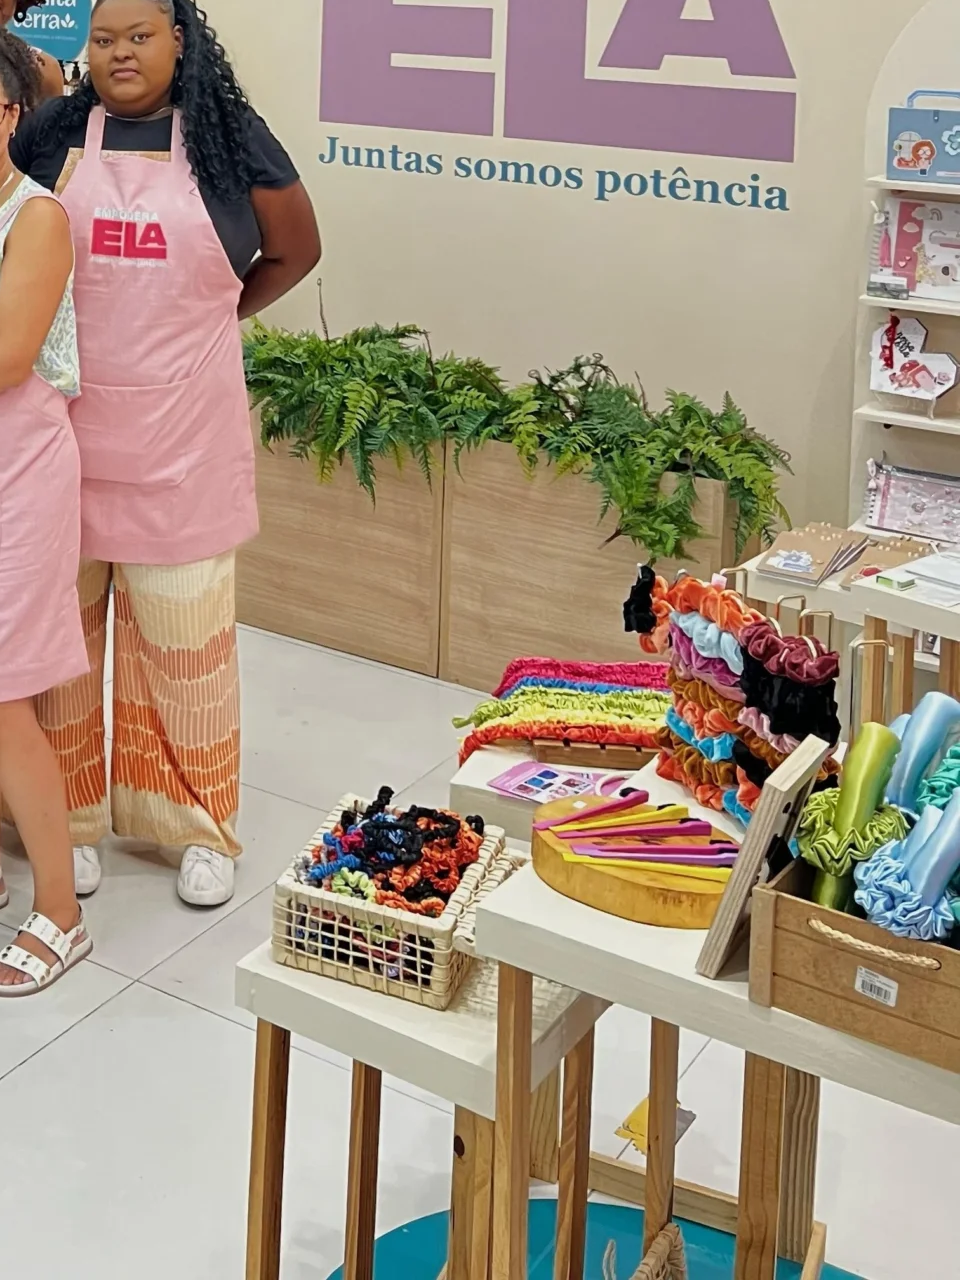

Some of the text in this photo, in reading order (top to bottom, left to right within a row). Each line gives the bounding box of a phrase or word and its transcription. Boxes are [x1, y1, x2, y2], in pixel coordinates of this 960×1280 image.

[318, 136, 791, 212] Juntas somos potência
[90, 218, 168, 260] ELA
